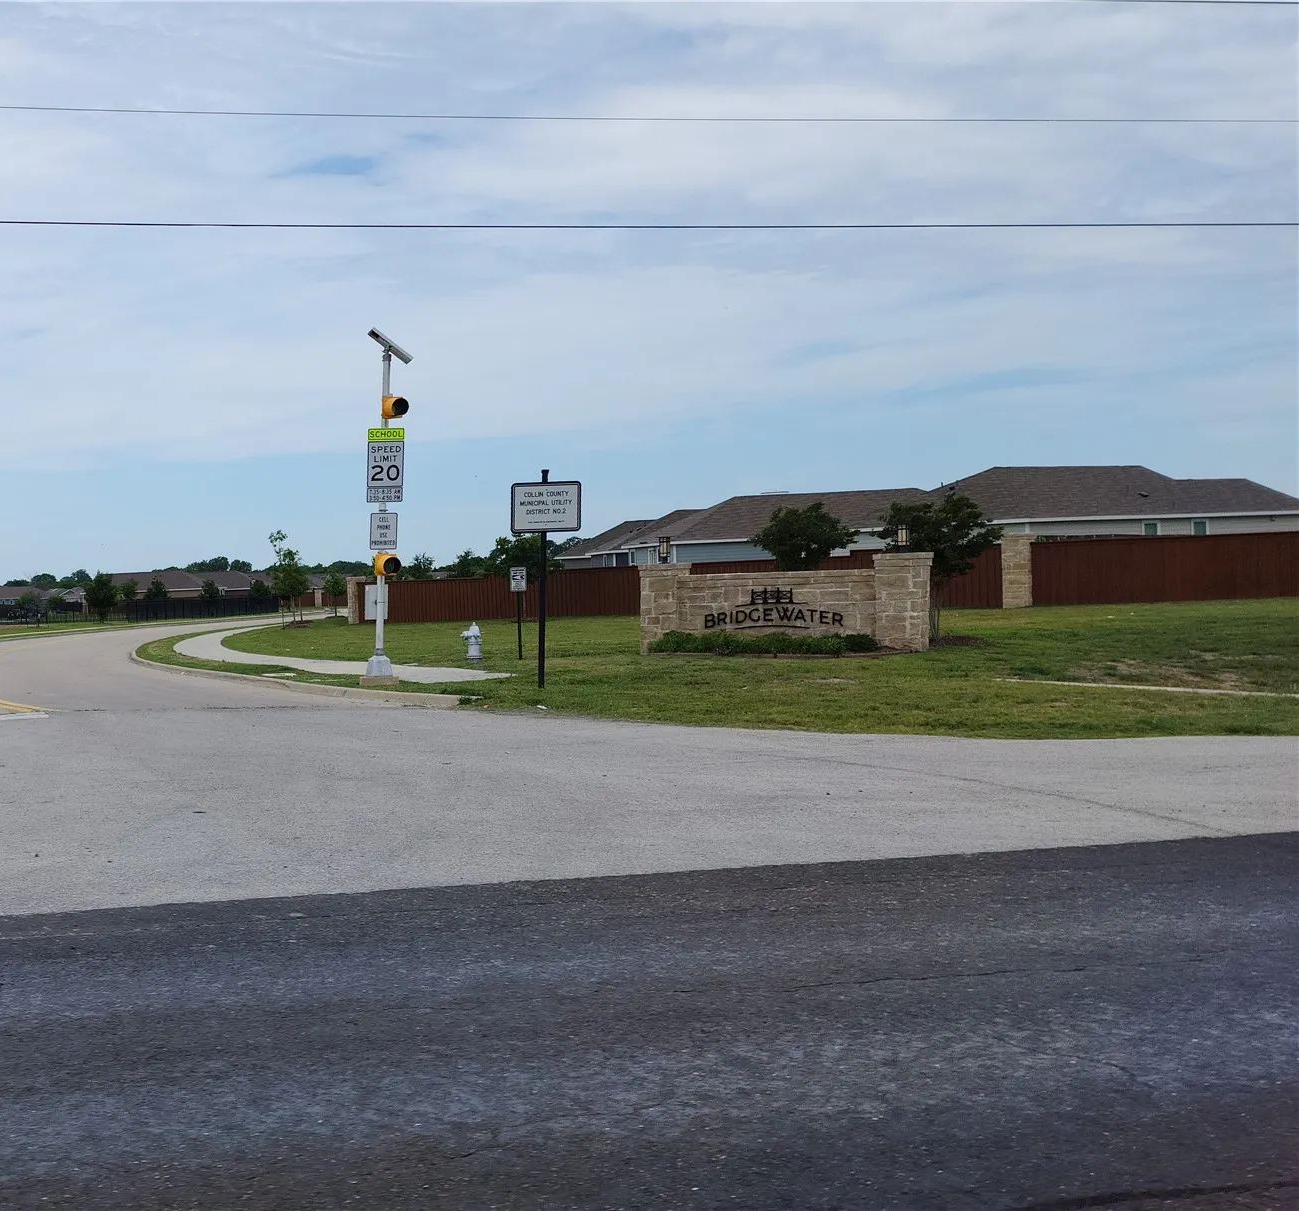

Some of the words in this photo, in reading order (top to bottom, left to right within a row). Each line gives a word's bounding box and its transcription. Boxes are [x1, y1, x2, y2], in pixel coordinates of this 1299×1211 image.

[369, 430, 403, 438] SCHOOL
[371, 445, 402, 453] SPEED
[373, 455, 398, 463] LIMIT
[371, 464, 400, 481] 20
[704, 606, 844, 629] BRIDGEWATER
